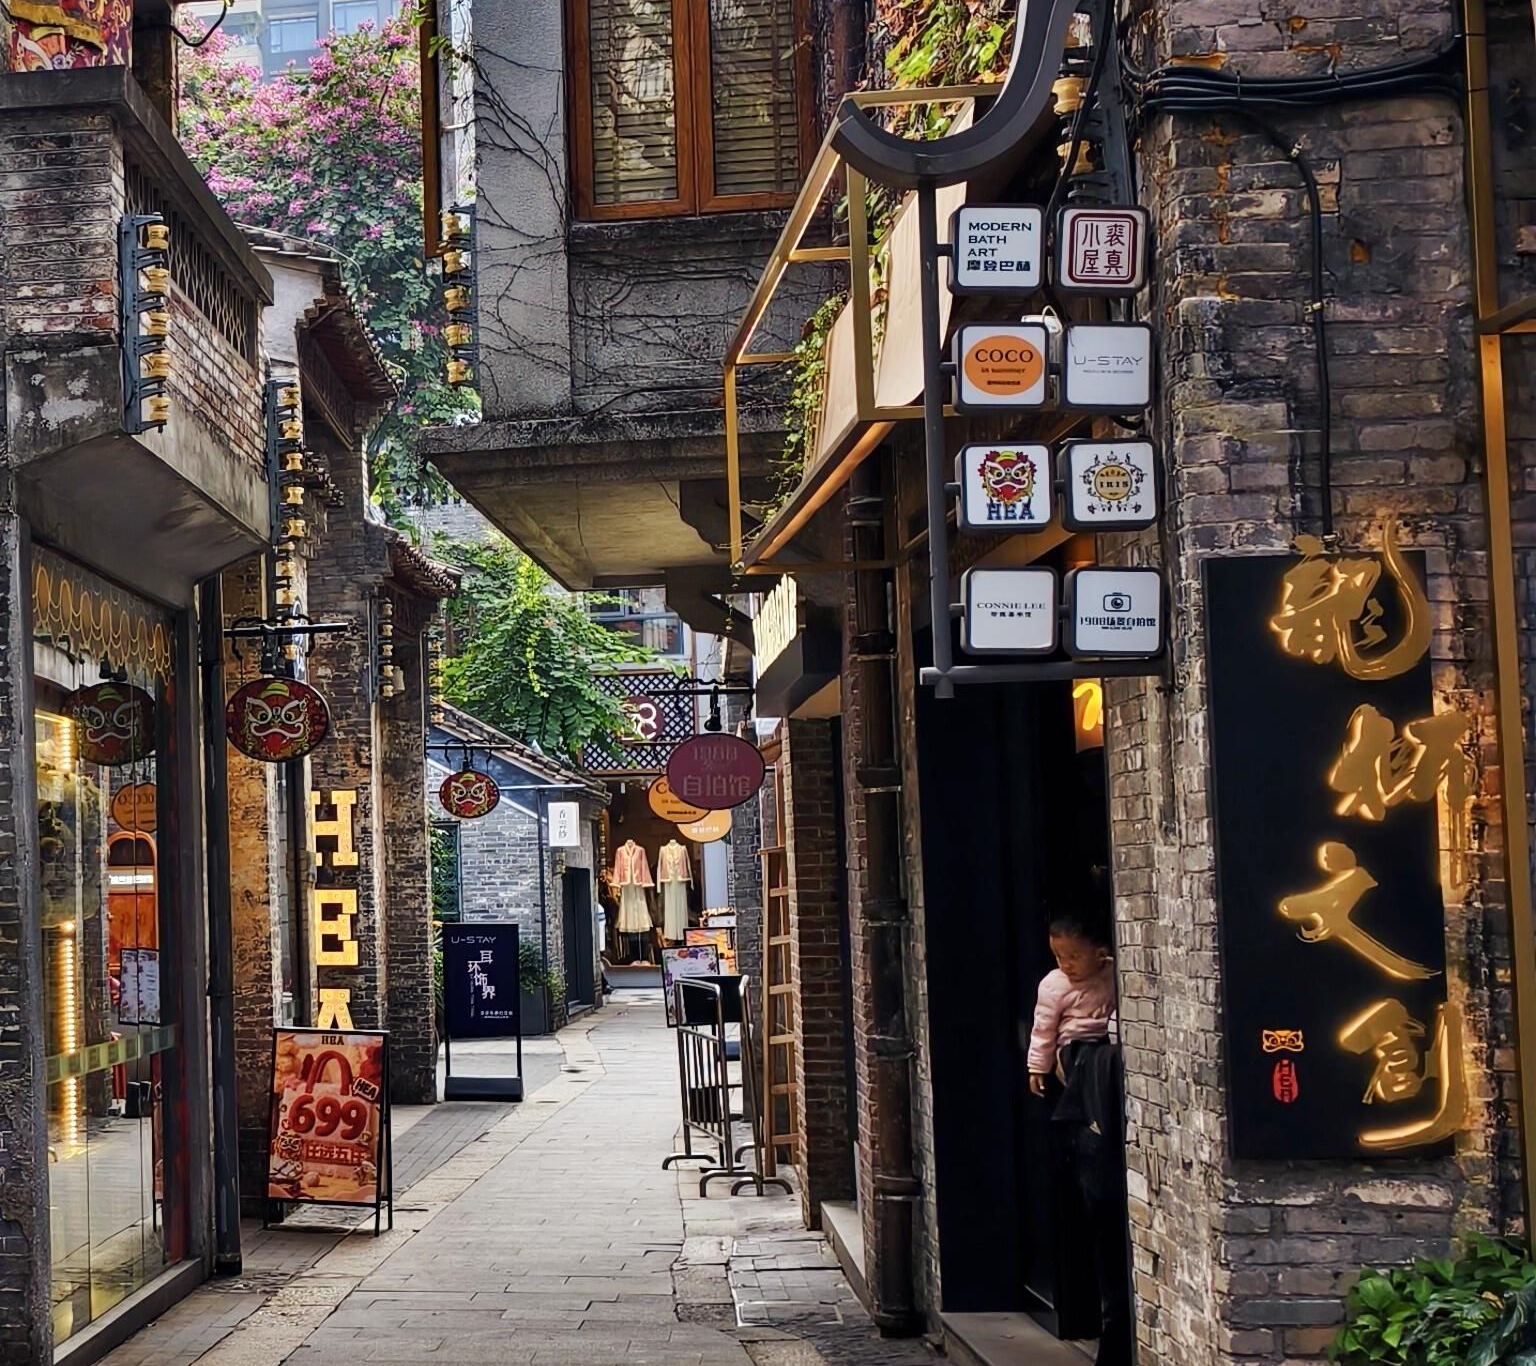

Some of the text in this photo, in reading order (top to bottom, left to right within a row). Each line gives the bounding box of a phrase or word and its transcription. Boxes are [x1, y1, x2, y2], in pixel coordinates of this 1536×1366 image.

[968, 222, 1032, 232] MODERN
[968, 235, 1007, 244] BATH
[967, 248, 999, 257] ART
[975, 349, 1034, 363] COCO
[1073, 355, 1144, 367] U-STAY
[986, 503, 1035, 521] HEA
[976, 602, 1047, 610] CONNIE LEE
[311, 790, 358, 1030] HEA
[451, 936, 497, 944] U-STAY
[321, 1035, 345, 1046] HEA
[357, 1079, 378, 1099] HEA
[288, 1094, 368, 1141] 699
